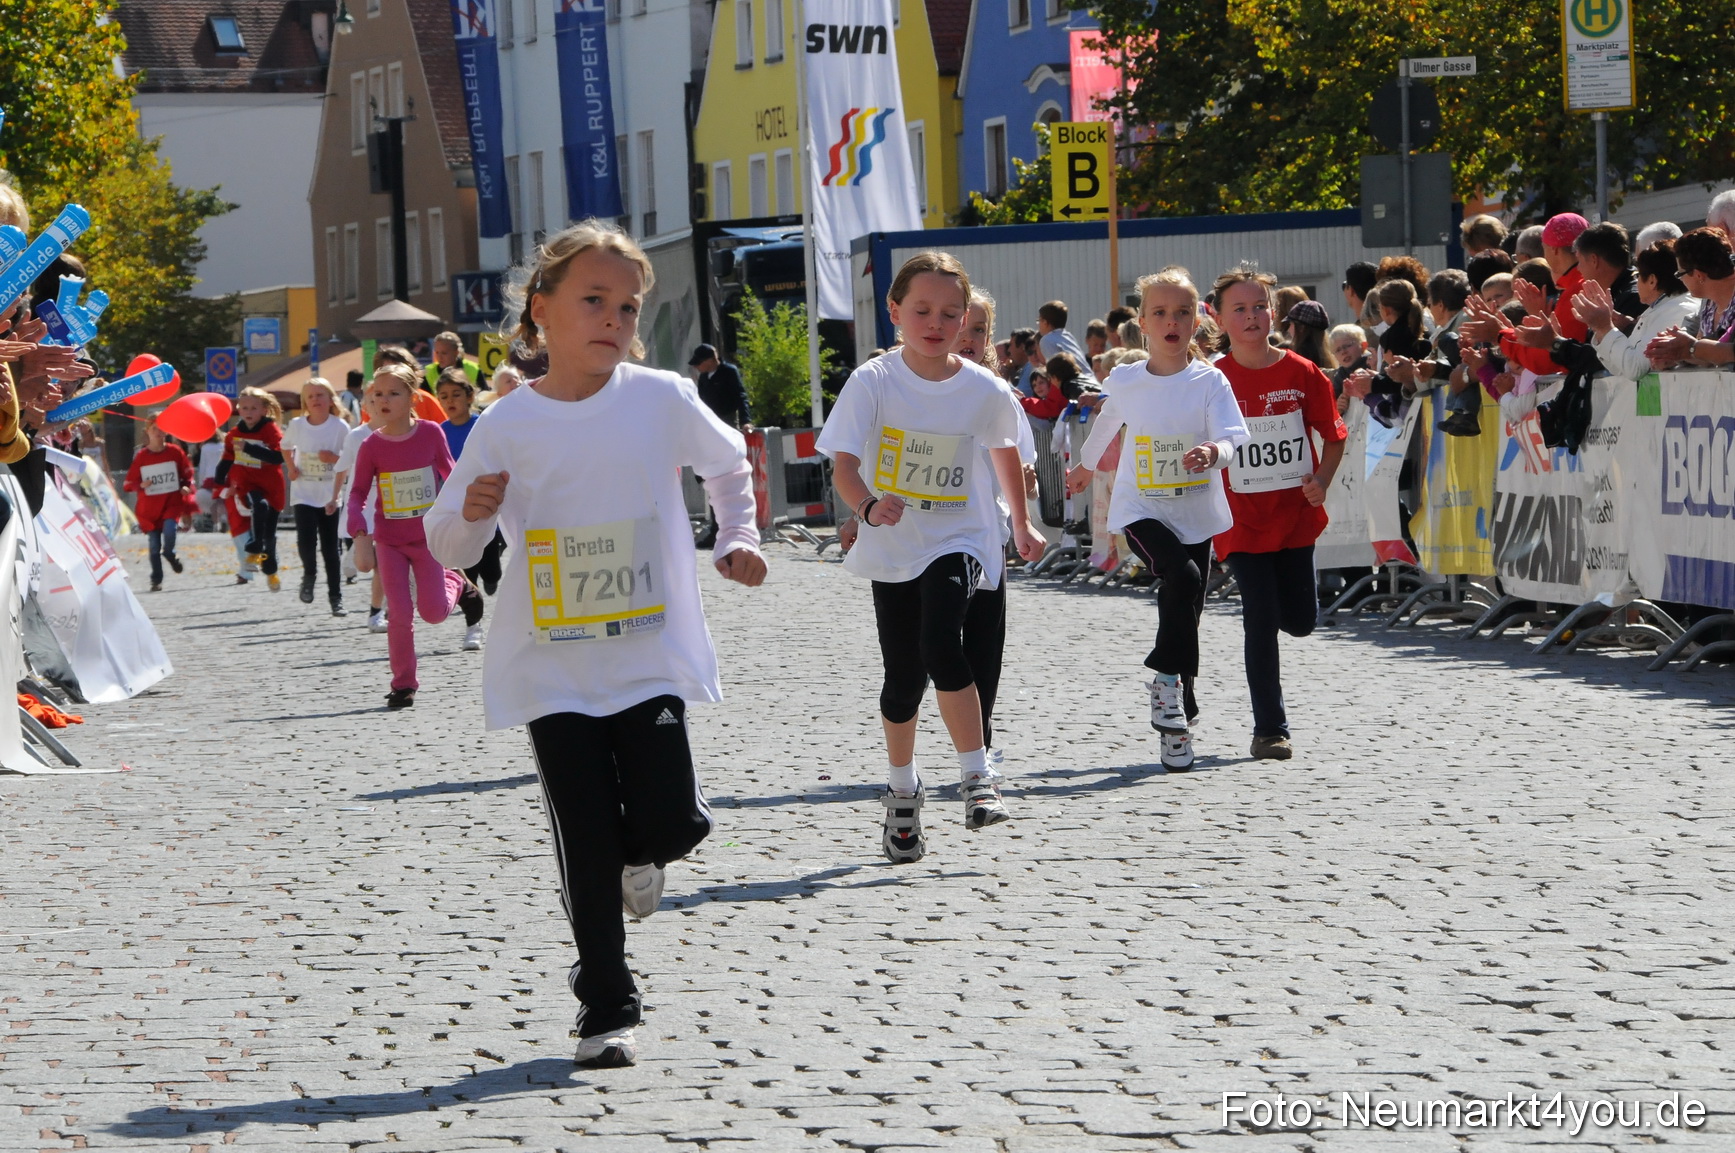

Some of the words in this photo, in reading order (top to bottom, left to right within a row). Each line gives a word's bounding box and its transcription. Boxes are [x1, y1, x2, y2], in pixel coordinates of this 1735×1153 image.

[806, 24, 887, 54] swn
[1576, 43, 1619, 51] Marktplatz
[1413, 61, 1440, 73] Ulmer
[1443, 61, 1471, 72] Gasse
[579, 22, 604, 131] RUPPERT
[755, 106, 787, 142] HOTEL
[1058, 126, 1107, 144] Block
[590, 135, 608, 178] K&L
[1068, 152, 1099, 198] B
[457, 278, 501, 314] KL
[209, 383, 236, 395] TAXI
[51, 384, 142, 424] www.maxi-dsl.de
[906, 439, 934, 455] Jule
[1154, 440, 1184, 453] Sarah
[1236, 437, 1304, 468] 10367
[881, 454, 894, 467] K3
[1139, 460, 1148, 468] K3
[394, 474, 422, 484] Antonia
[905, 462, 965, 488] 7108
[396, 485, 432, 503] 7196
[563, 536, 615, 558] Greta
[536, 572, 552, 588] K3
[569, 561, 653, 603] 7201
[621, 612, 665, 629] PFLEIDERER
